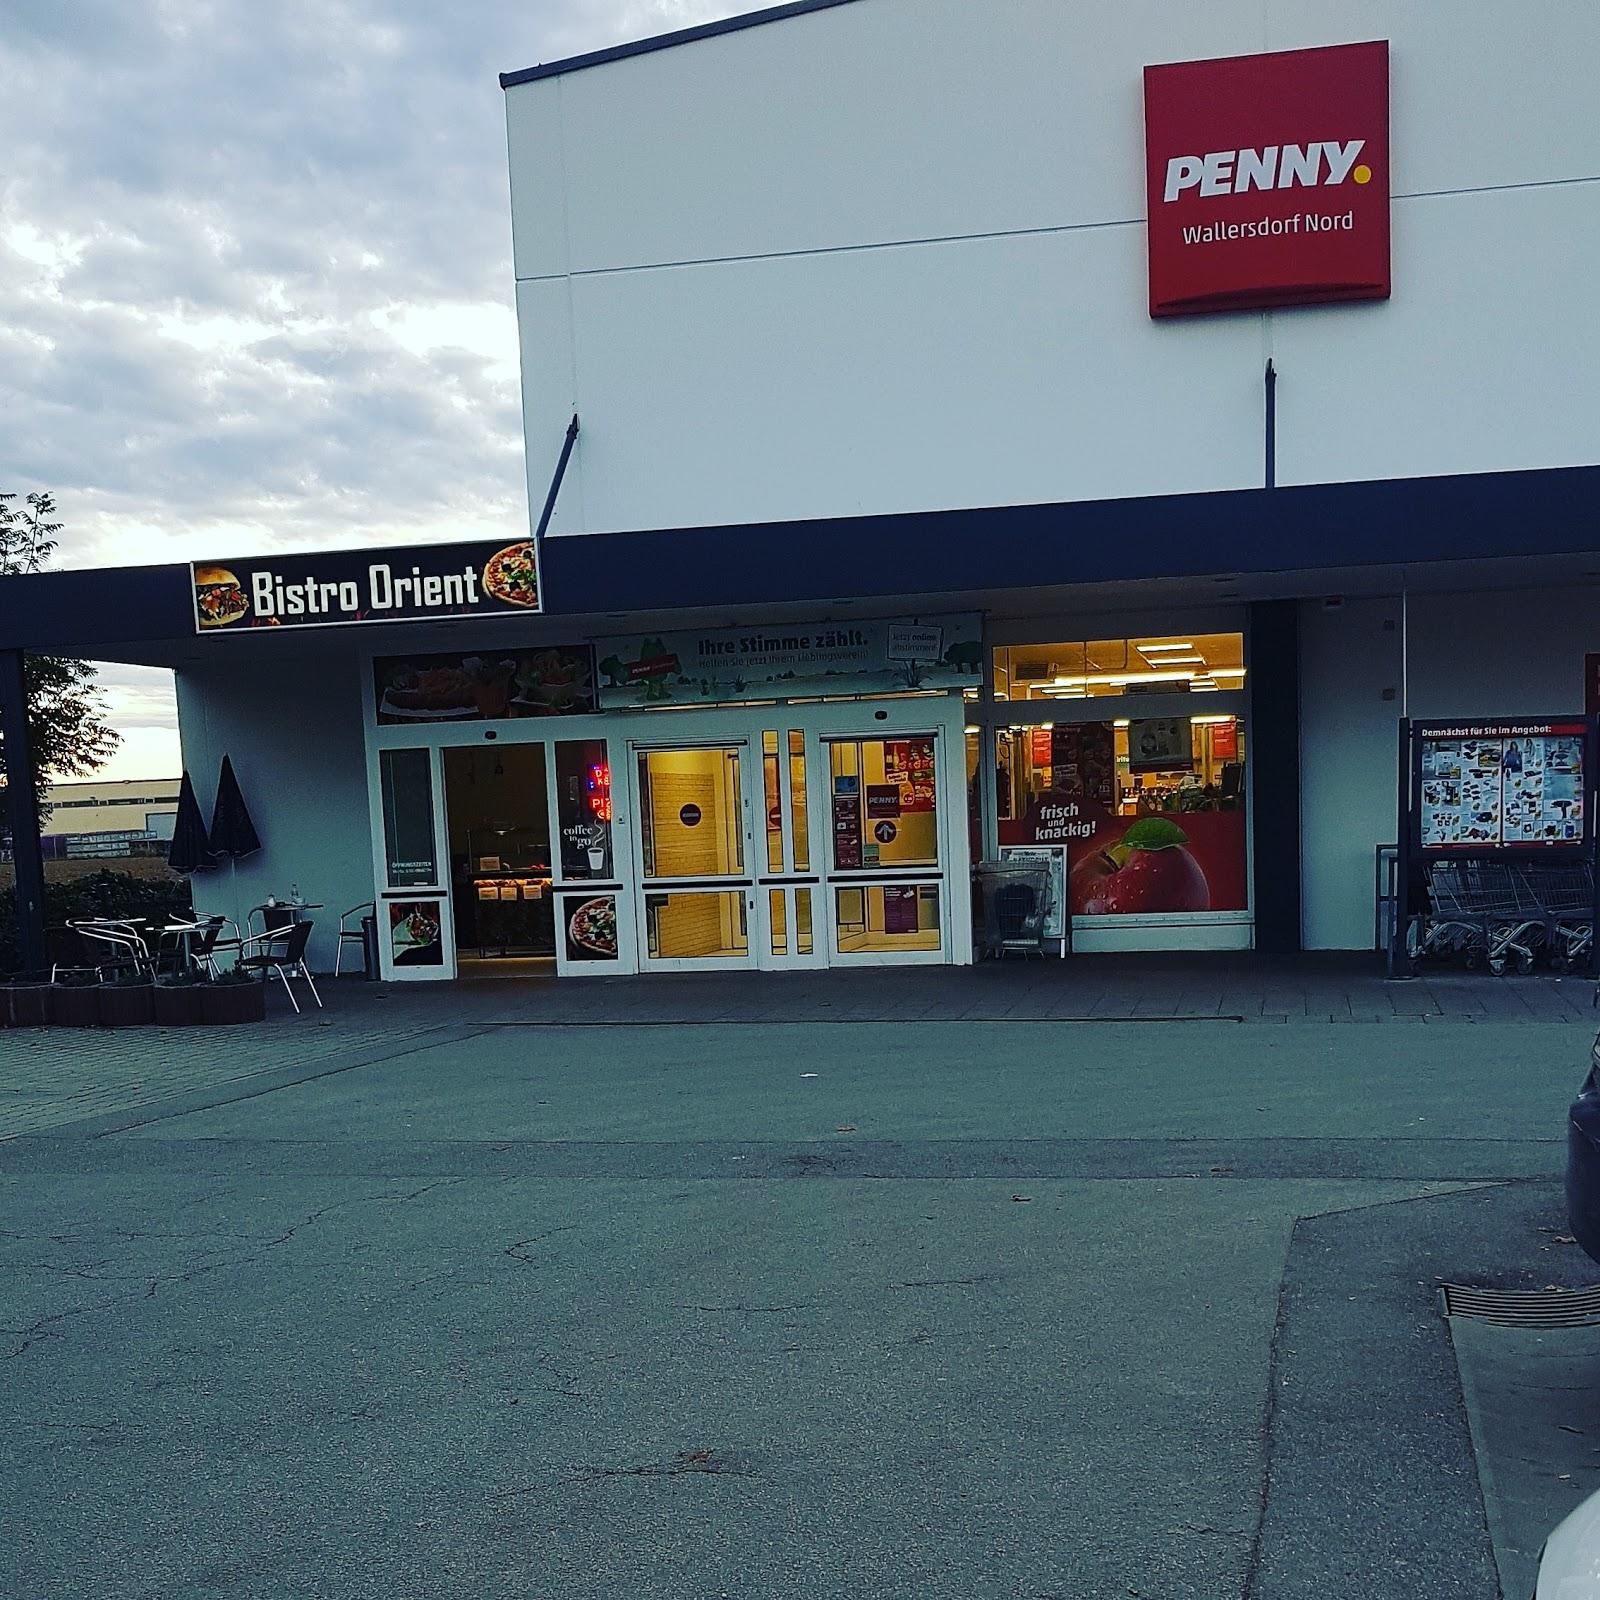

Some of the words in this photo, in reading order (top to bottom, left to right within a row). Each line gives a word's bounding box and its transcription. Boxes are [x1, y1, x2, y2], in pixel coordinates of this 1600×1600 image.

[1182, 213, 1300, 245] Wallersdorf
[1305, 210, 1353, 233] Nord
[251, 571, 359, 617] Bistro
[368, 564, 479, 609] Orient
[698, 639, 735, 655] Ihre
[740, 634, 810, 653] Stimme
[815, 630, 868, 649] zählt.
[1421, 728, 1469, 737] Demnächst
[1470, 727, 1483, 736] für
[1484, 726, 1497, 735] Sie
[1498, 726, 1510, 735] im
[1511, 724, 1552, 735] Angebot:
[1040, 802, 1079, 820] frisch
[563, 824, 593, 836] coffee
[1035, 820, 1096, 841] knackig!
[1047, 817, 1065, 827] und
[576, 837, 591, 850] go
